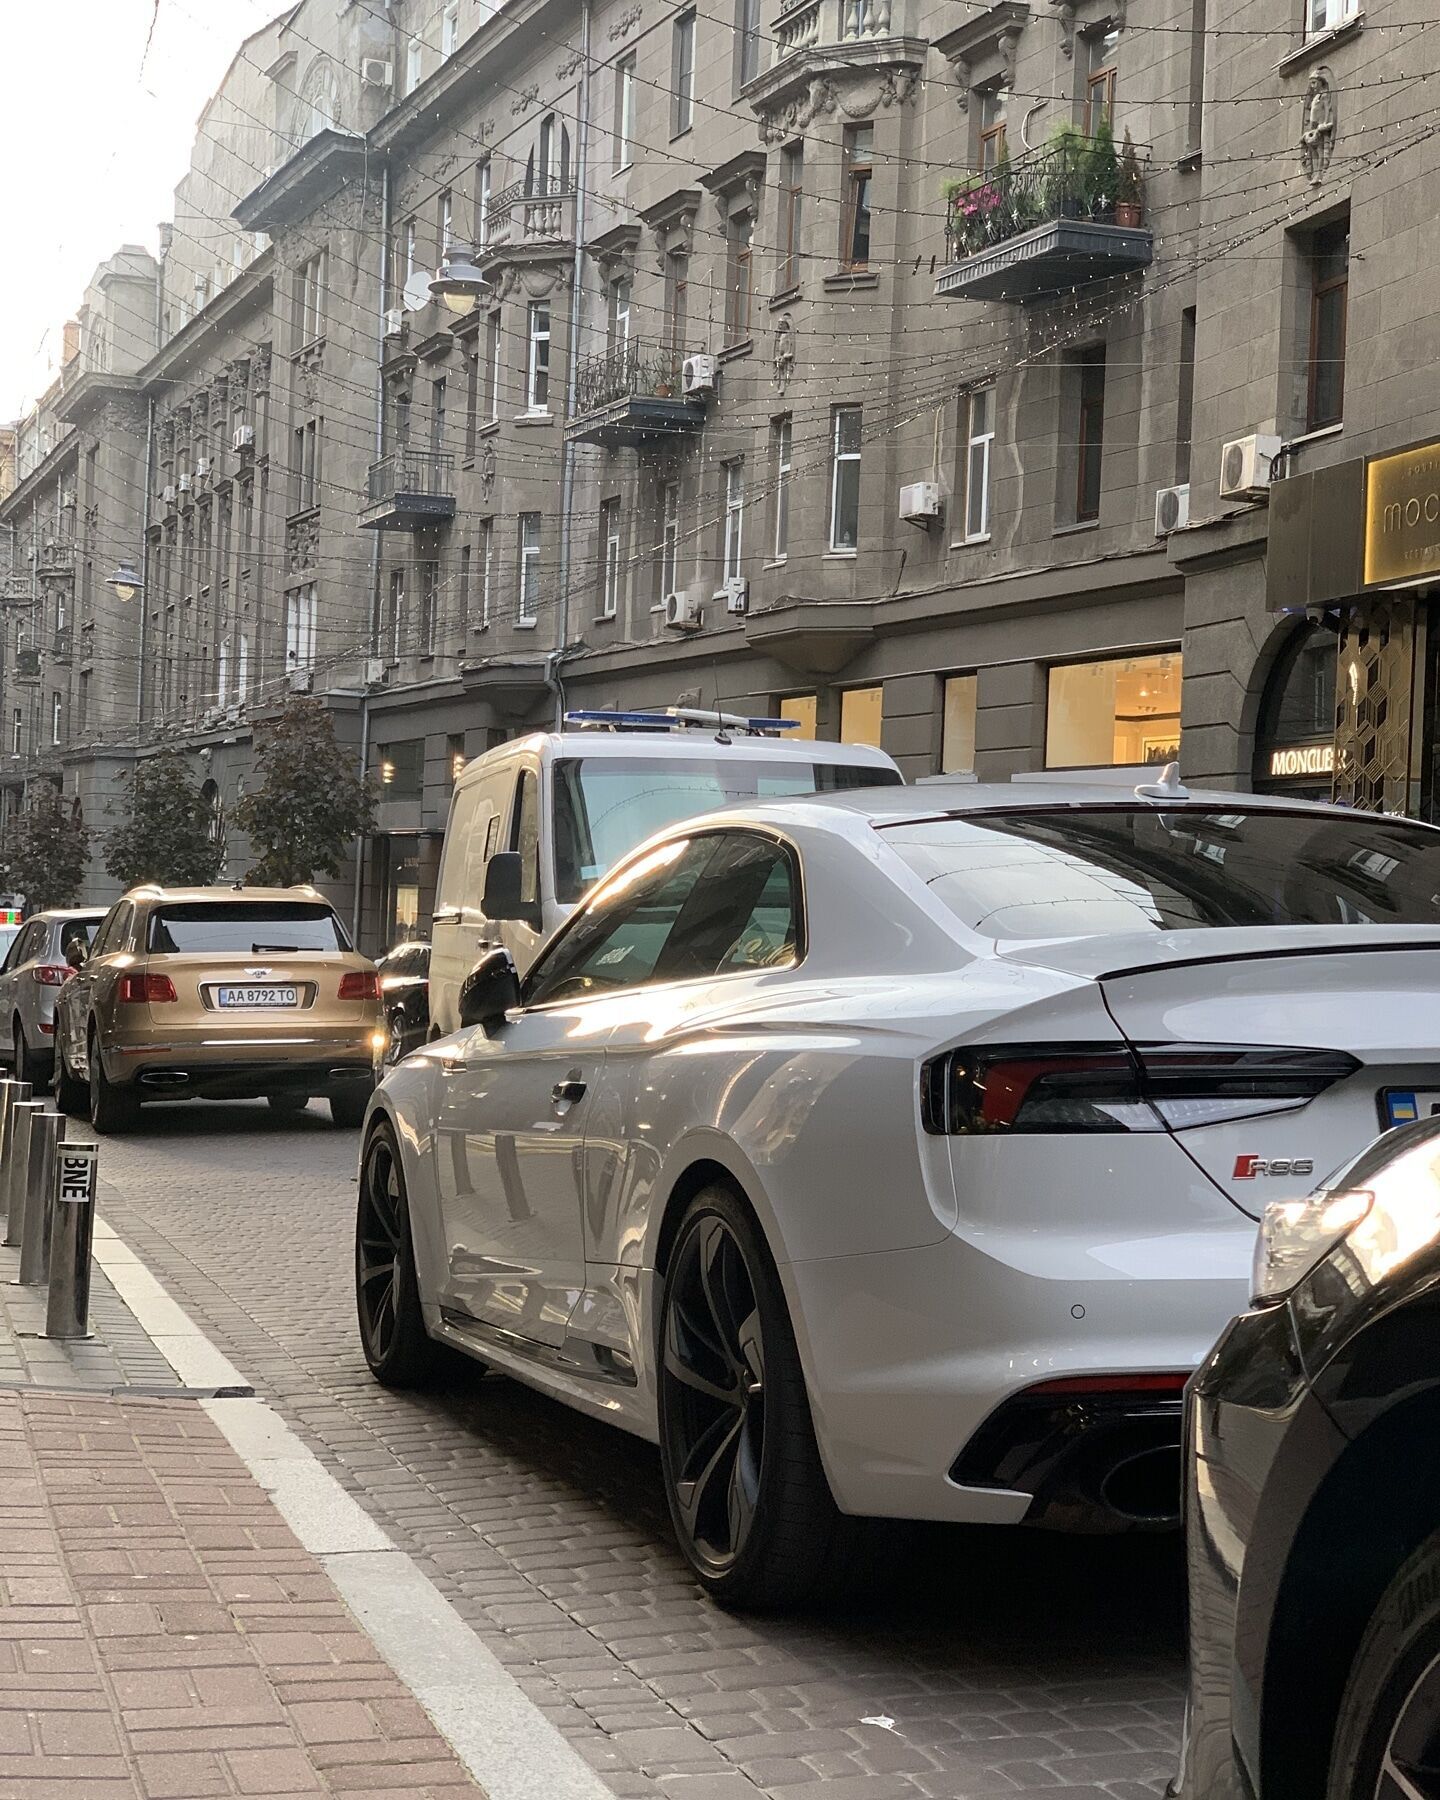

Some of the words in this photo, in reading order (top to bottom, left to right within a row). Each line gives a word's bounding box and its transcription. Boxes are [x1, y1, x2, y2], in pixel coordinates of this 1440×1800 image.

[227, 990, 245, 1002] AA
[247, 990, 276, 1001] 8792
[277, 989, 295, 1001] TO
[1245, 1157, 1314, 1177] RS5
[62, 1157, 87, 1198] BNE
